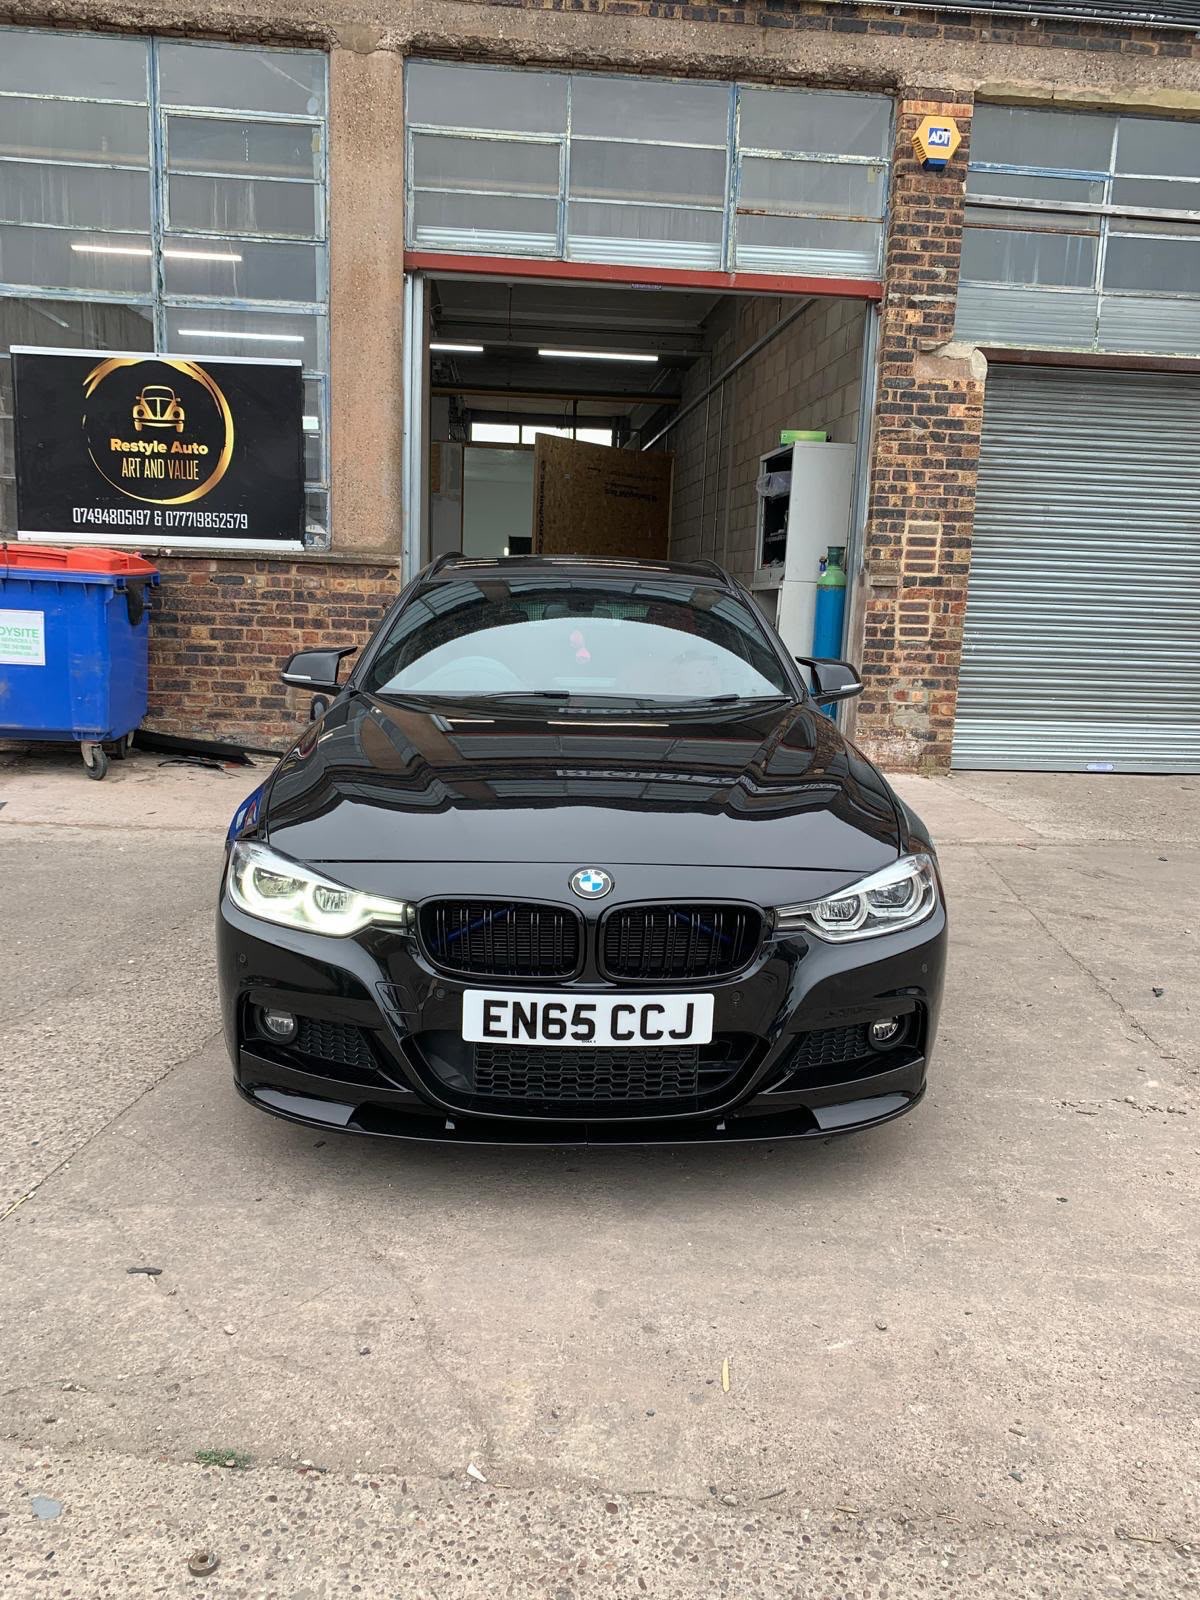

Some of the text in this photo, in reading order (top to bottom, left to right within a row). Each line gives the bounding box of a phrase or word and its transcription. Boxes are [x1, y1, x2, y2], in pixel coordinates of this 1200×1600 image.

[928, 130, 950, 145] ADT
[110, 438, 209, 455] Restyle Auto
[121, 458, 200, 480] ART AND VALUE
[72, 507, 248, 529] 07494805197 & 077719852579
[483, 1000, 695, 1040] EN65 CCJ
